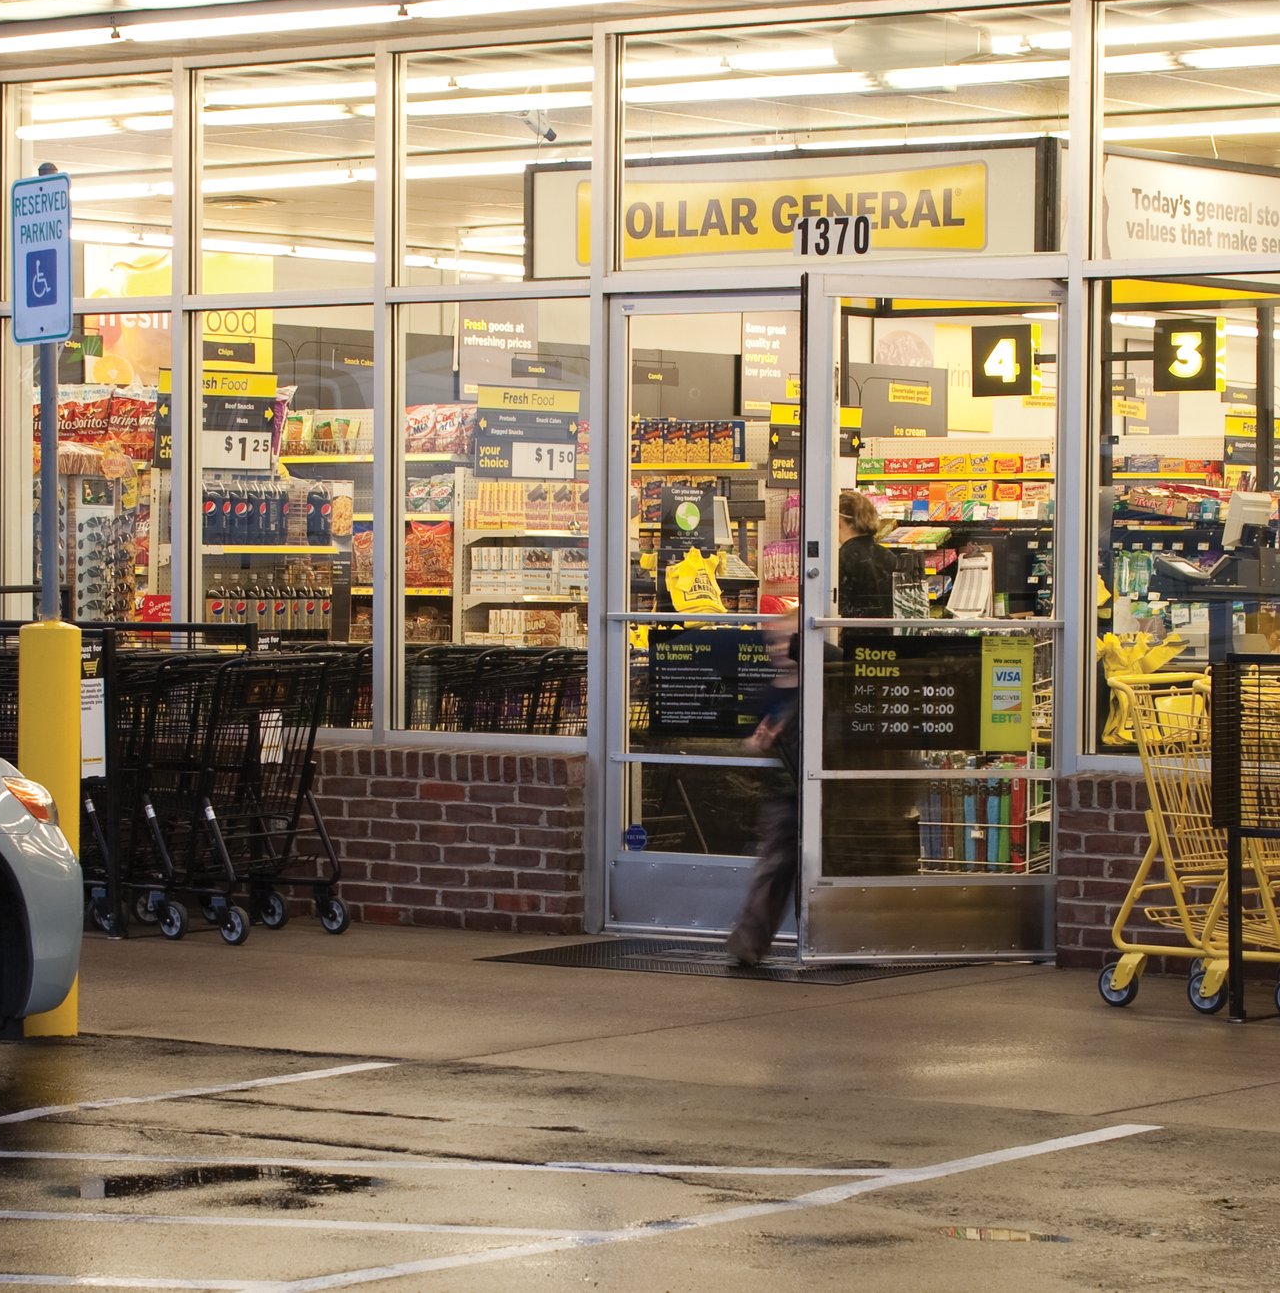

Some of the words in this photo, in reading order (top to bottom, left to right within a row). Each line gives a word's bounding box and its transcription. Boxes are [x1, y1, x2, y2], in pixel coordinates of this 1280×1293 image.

[15, 191, 67, 217] RESERVED
[1132, 188, 1191, 219] Today's
[1196, 200, 1252, 223] general
[626, 197, 758, 240] OLLAR
[21, 220, 62, 244] PARKING
[797, 216, 869, 256] 1370
[1126, 218, 1176, 244] values
[1181, 223, 1212, 248] that
[1217, 229, 1257, 253] make
[207, 310, 256, 334] ood
[464, 319, 487, 331] Fresh
[488, 322, 514, 333] goods
[515, 323, 524, 333] at
[745, 323, 766, 333] Same
[767, 324, 786, 336] great
[64, 340, 81, 349] Chips
[464, 335, 505, 349] refreshing
[507, 338, 532, 349] prices
[745, 338, 771, 350] quality
[772, 338, 780, 349] at
[218, 348, 234, 357] Chips
[1169, 331, 1202, 378] 3
[745, 353, 778, 365] everyday
[984, 339, 1020, 382] 4
[648, 372, 663, 381] Candy
[745, 367, 758, 377] low
[759, 367, 781, 379] prices
[202, 377, 218, 390] esh
[221, 378, 249, 391] Food
[503, 392, 528, 404] Fresh
[531, 394, 555, 406] Food
[894, 426, 904, 436] ice
[905, 427, 926, 437] cream
[1243, 422, 1257, 433] Fres
[479, 445, 500, 456] your
[479, 457, 509, 468] choice
[772, 458, 795, 470] great
[772, 469, 798, 480] values
[258, 637, 270, 645] Just
[258, 644, 269, 652] you
[656, 643, 670, 652] We
[672, 644, 694, 652] want
[696, 644, 711, 653] you
[738, 644, 764, 652] We're
[656, 652, 666, 660] to
[666, 652, 692, 660] know:
[738, 654, 751, 662] for
[855, 648, 896, 661] Store
[855, 664, 900, 677] Hours
[996, 671, 1021, 682] VISA
[854, 685, 876, 696] M-F:
[882, 685, 910, 697] 7:00
[922, 686, 955, 697] 10:00
[854, 703, 875, 714] Sat:
[882, 703, 910, 714] 7:00
[922, 704, 954, 715] 10:00
[992, 714, 1012, 724] EBT
[851, 721, 875, 732] Sun:
[881, 722, 909, 733] 7:00
[922, 722, 954, 733] 10:00
